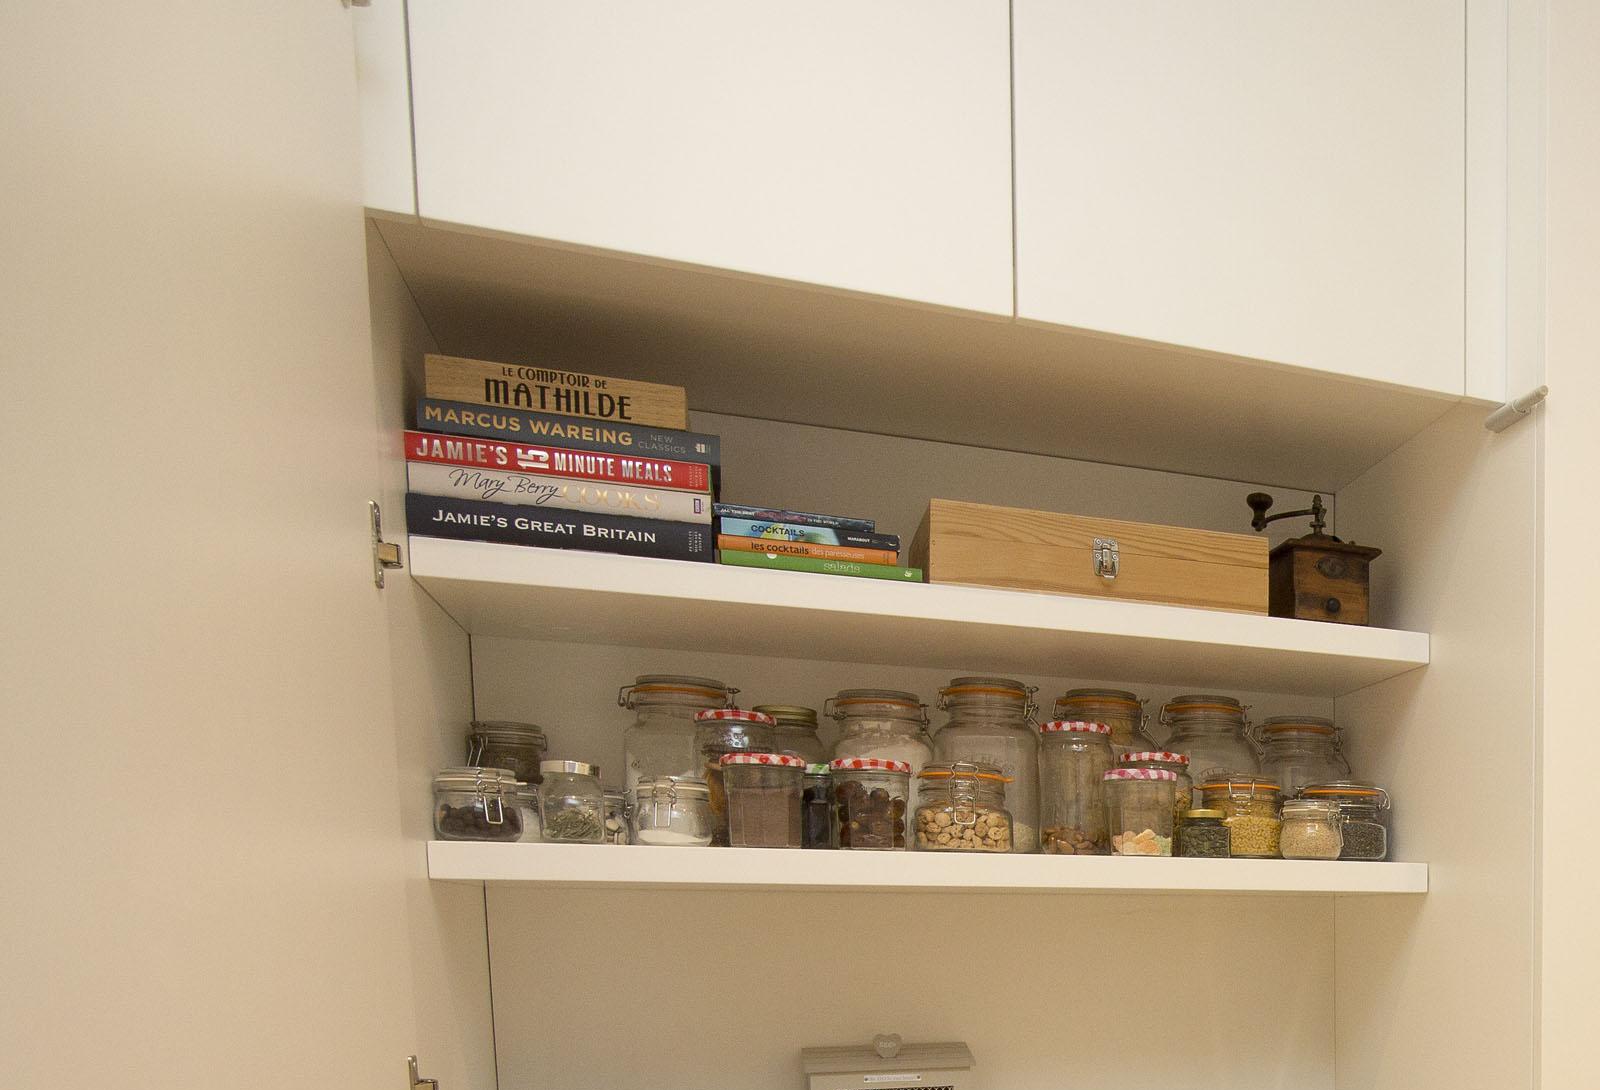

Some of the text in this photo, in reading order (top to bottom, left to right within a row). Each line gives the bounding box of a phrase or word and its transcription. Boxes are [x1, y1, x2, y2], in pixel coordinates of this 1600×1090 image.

[502, 366, 607, 390] LE COMPTOIR DE
[485, 378, 632, 421] MATHILDE
[425, 404, 633, 446] MARCUS WAREING
[650, 434, 673, 444] NEW
[416, 437, 508, 466] JAMIE'S
[516, 447, 550, 469] 15
[554, 452, 615, 477] MINUTE
[621, 459, 672, 482] MEALS
[638, 441, 686, 454] CLASSICS
[448, 468, 511, 500] Mary
[507, 475, 563, 505] Berry
[562, 483, 661, 512] COOKS
[432, 509, 657, 544] JAMIE'S GREAT BRITAIN
[751, 524, 805, 537] COCKTAILS
[751, 542, 765, 551] les
[766, 543, 809, 555] cocktails
